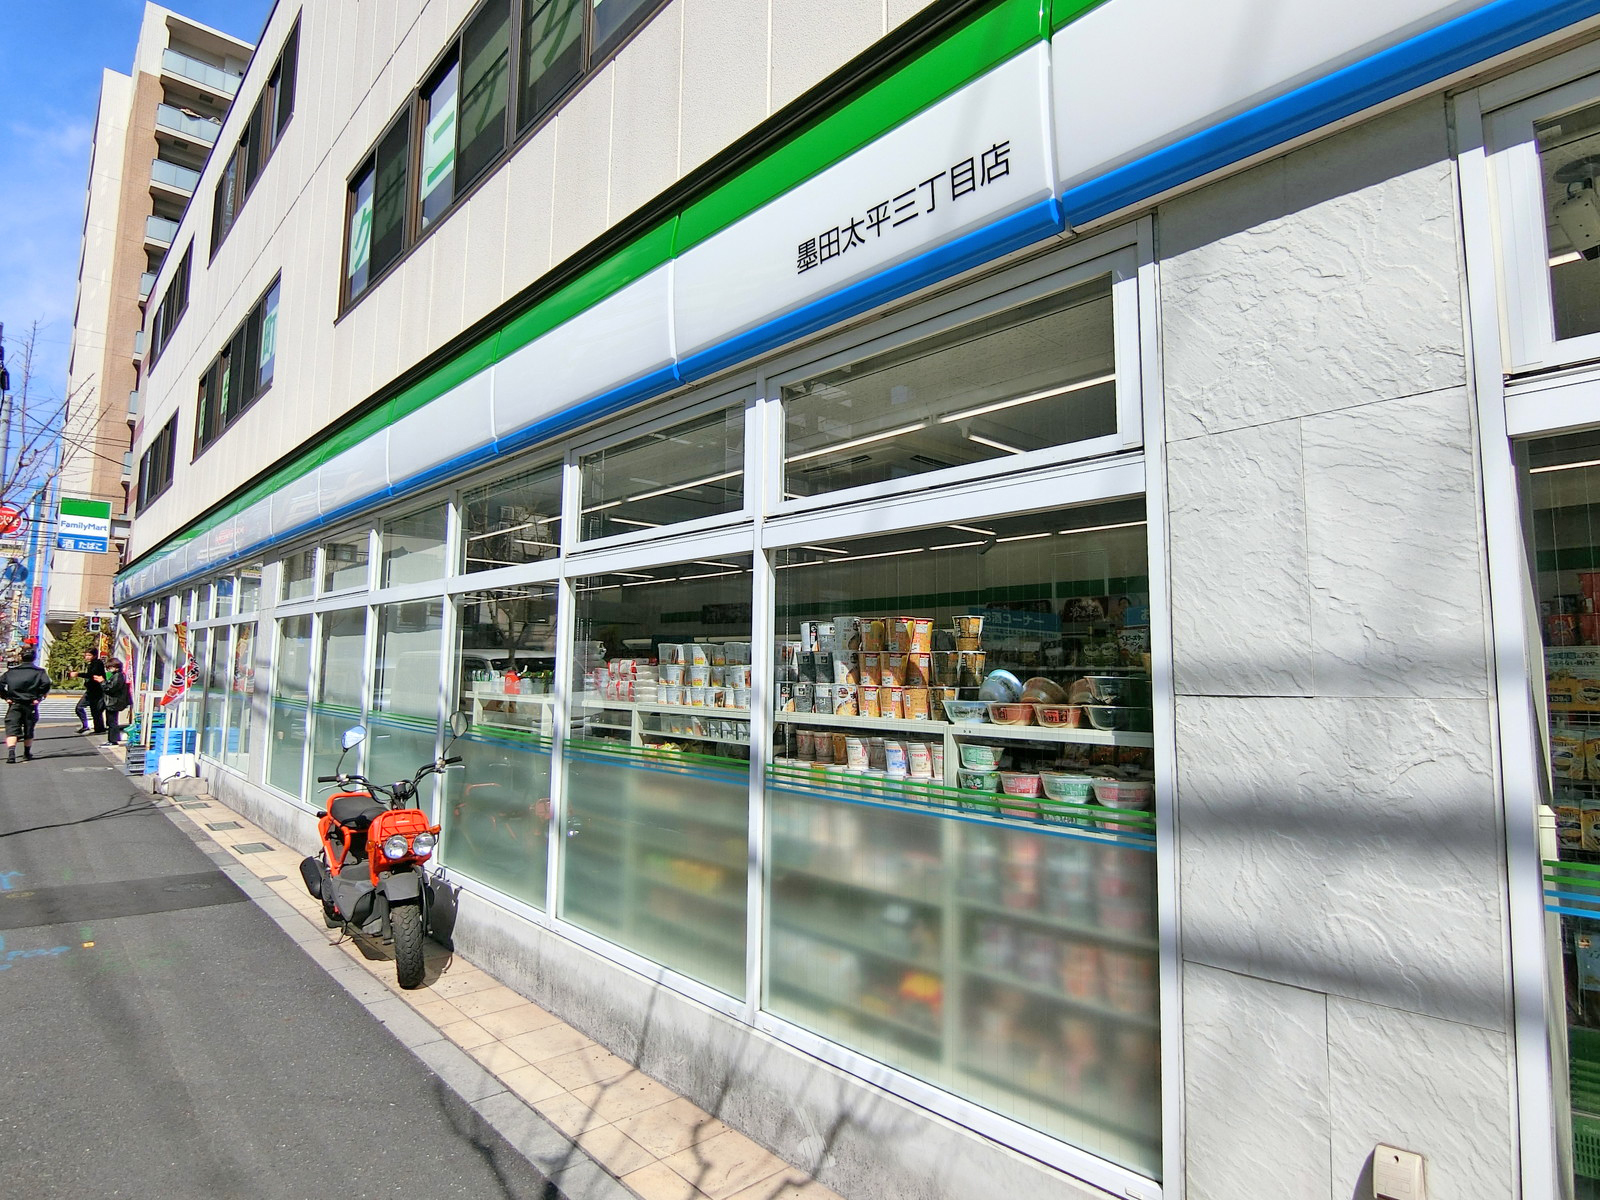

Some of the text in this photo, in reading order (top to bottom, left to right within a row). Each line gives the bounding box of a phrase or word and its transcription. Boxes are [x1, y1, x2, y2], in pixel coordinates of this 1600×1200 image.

[797, 140, 1010, 275] 墨田太平三丁目店
[60, 520, 108, 531] FamilyMart
[62, 539, 103, 551] 酒 たばこ
